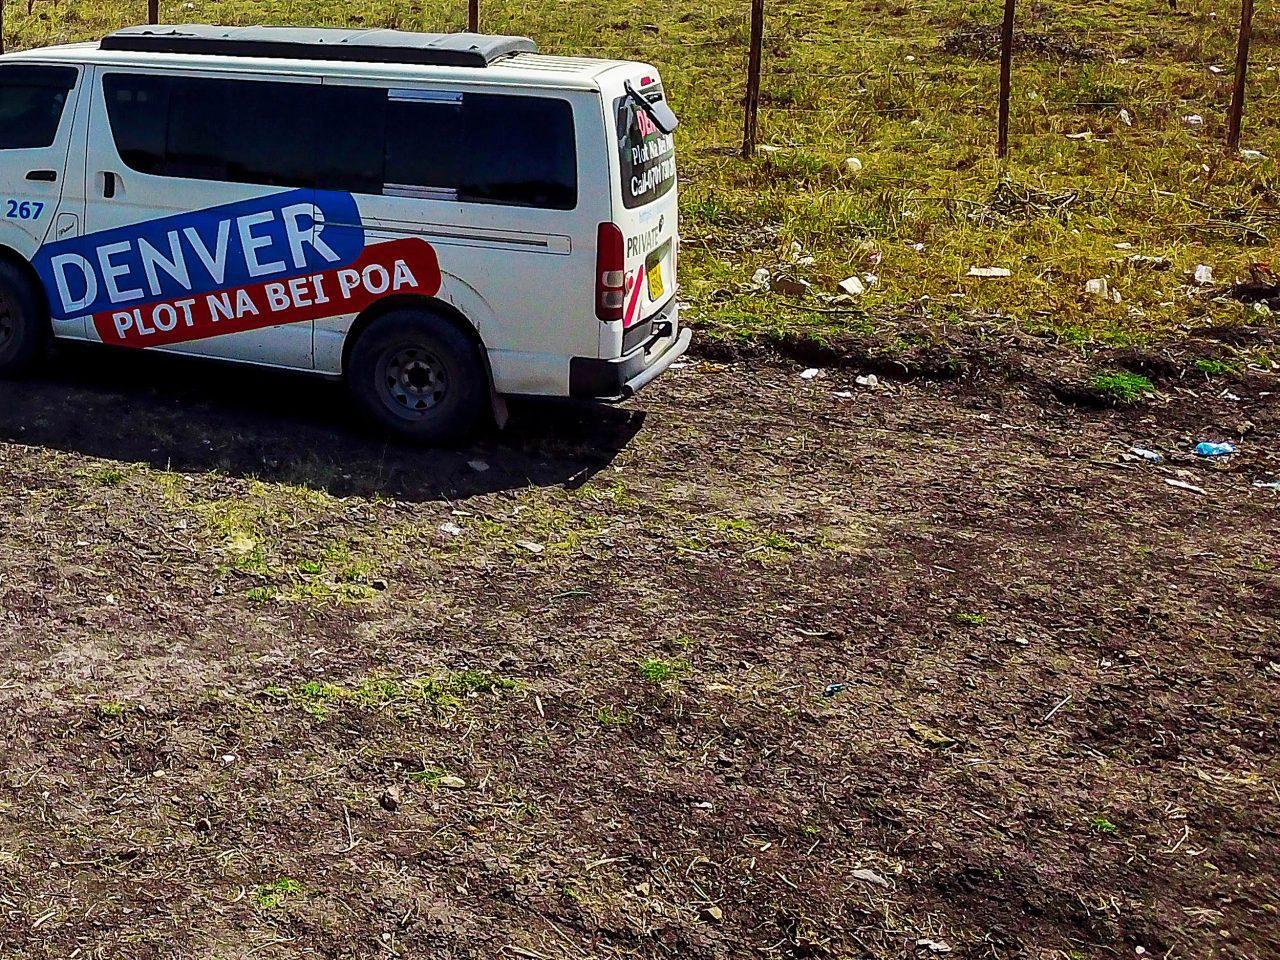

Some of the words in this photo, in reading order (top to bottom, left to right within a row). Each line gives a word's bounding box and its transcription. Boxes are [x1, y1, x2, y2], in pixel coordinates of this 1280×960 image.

[6, 199, 44, 220] 267
[51, 203, 340, 314] DENVER
[627, 225, 658, 257] PRIVATE
[111, 302, 196, 340] PLOT
[207, 284, 260, 320] NA
[270, 273, 329, 310] BEI
[339, 259, 419, 300] POA
